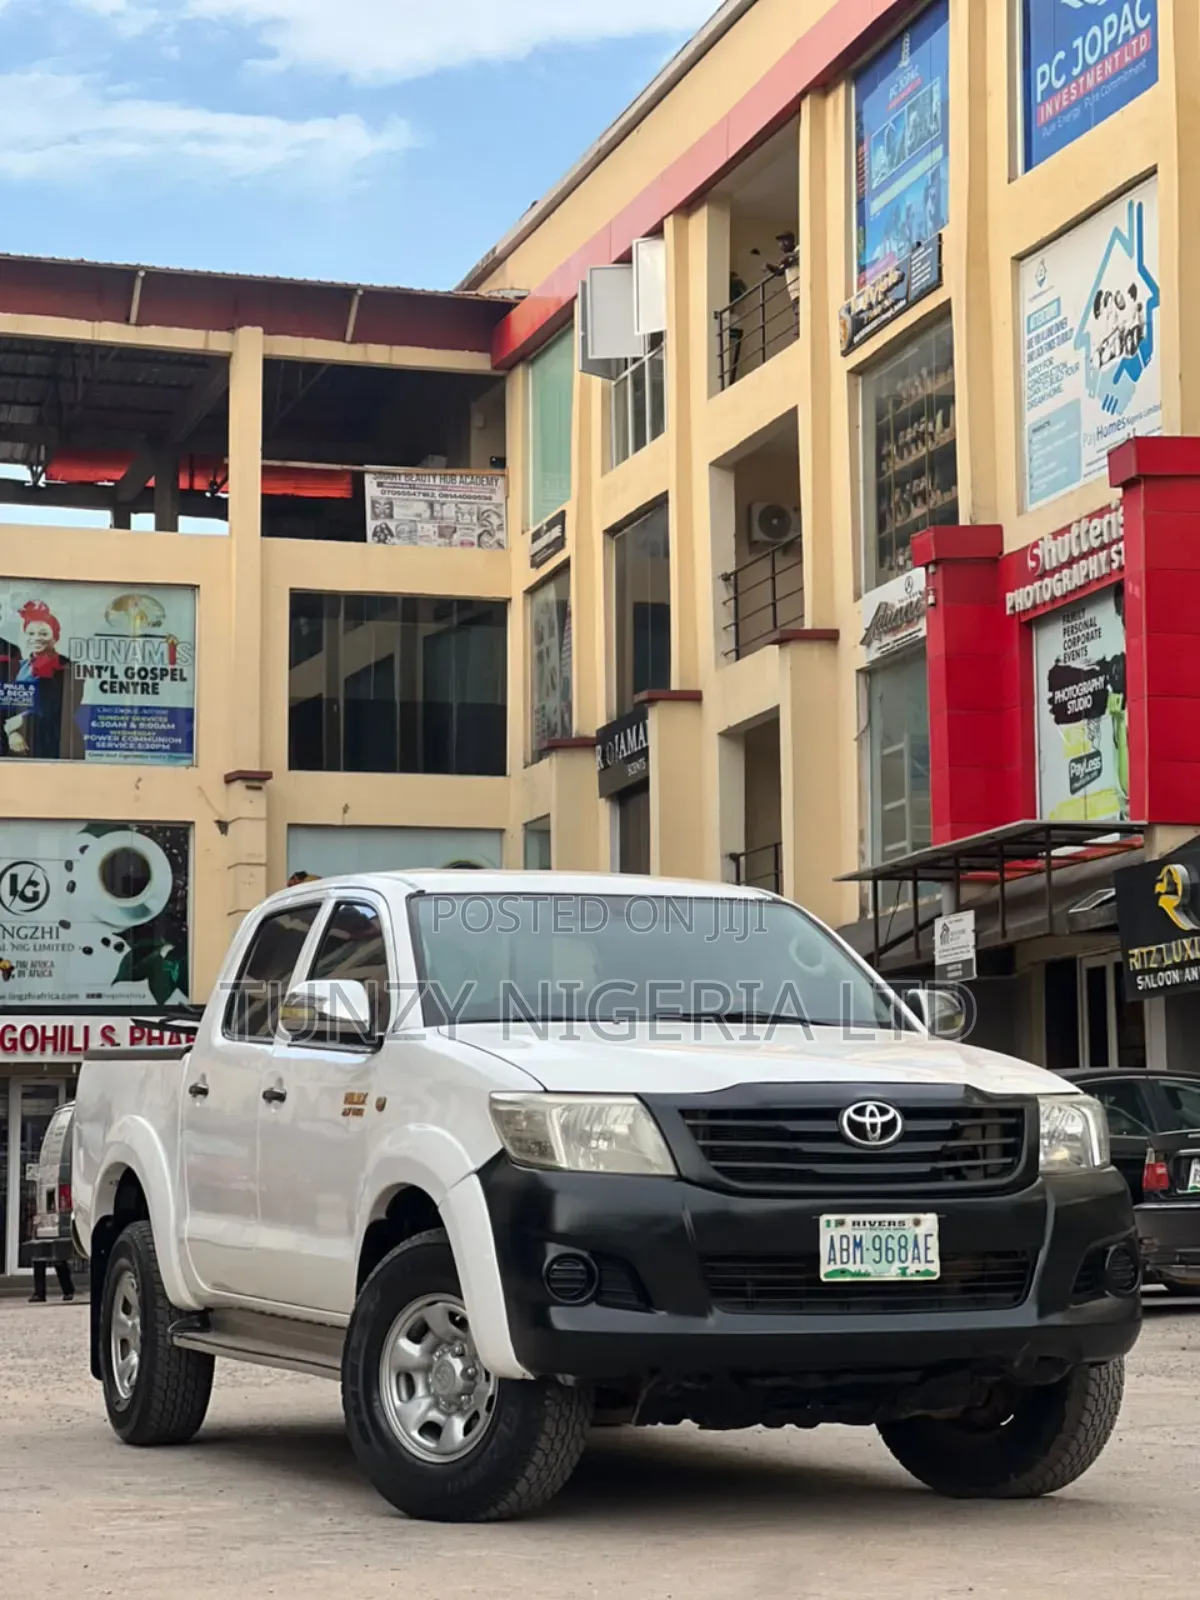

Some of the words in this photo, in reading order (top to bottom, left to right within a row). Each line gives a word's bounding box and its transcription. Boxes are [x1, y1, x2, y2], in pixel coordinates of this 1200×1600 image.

[1036, 50, 1066, 104] PC
[1072, 0, 1151, 76] JOPAC
[1040, 52, 1121, 125] INVESTMENT
[1124, 33, 1148, 63] LTD
[1005, 549, 1110, 616] PHOTOGRAPHY
[1063, 615, 1098, 638] PERSONAL
[1063, 626, 1102, 651] CORPORATE
[1063, 644, 1089, 664] EVENTS
[76, 664, 119, 679] INT'L
[124, 666, 188, 682] GOSPEL
[99, 680, 160, 695] CENTRE
[1054, 674, 1105, 704] PHOTOGRAPHY
[1067, 694, 1093, 715] STUDIO
[84, 734, 120, 742] POWER
[121, 735, 182, 744] COMMUNION
[96, 741, 135, 749] SERVICE
[33, 943, 75, 952] LIMITED
[1128, 945, 1158, 971] RITZ
[1136, 969, 1180, 991] SALOON
[1184, 964, 1200, 982] AN
